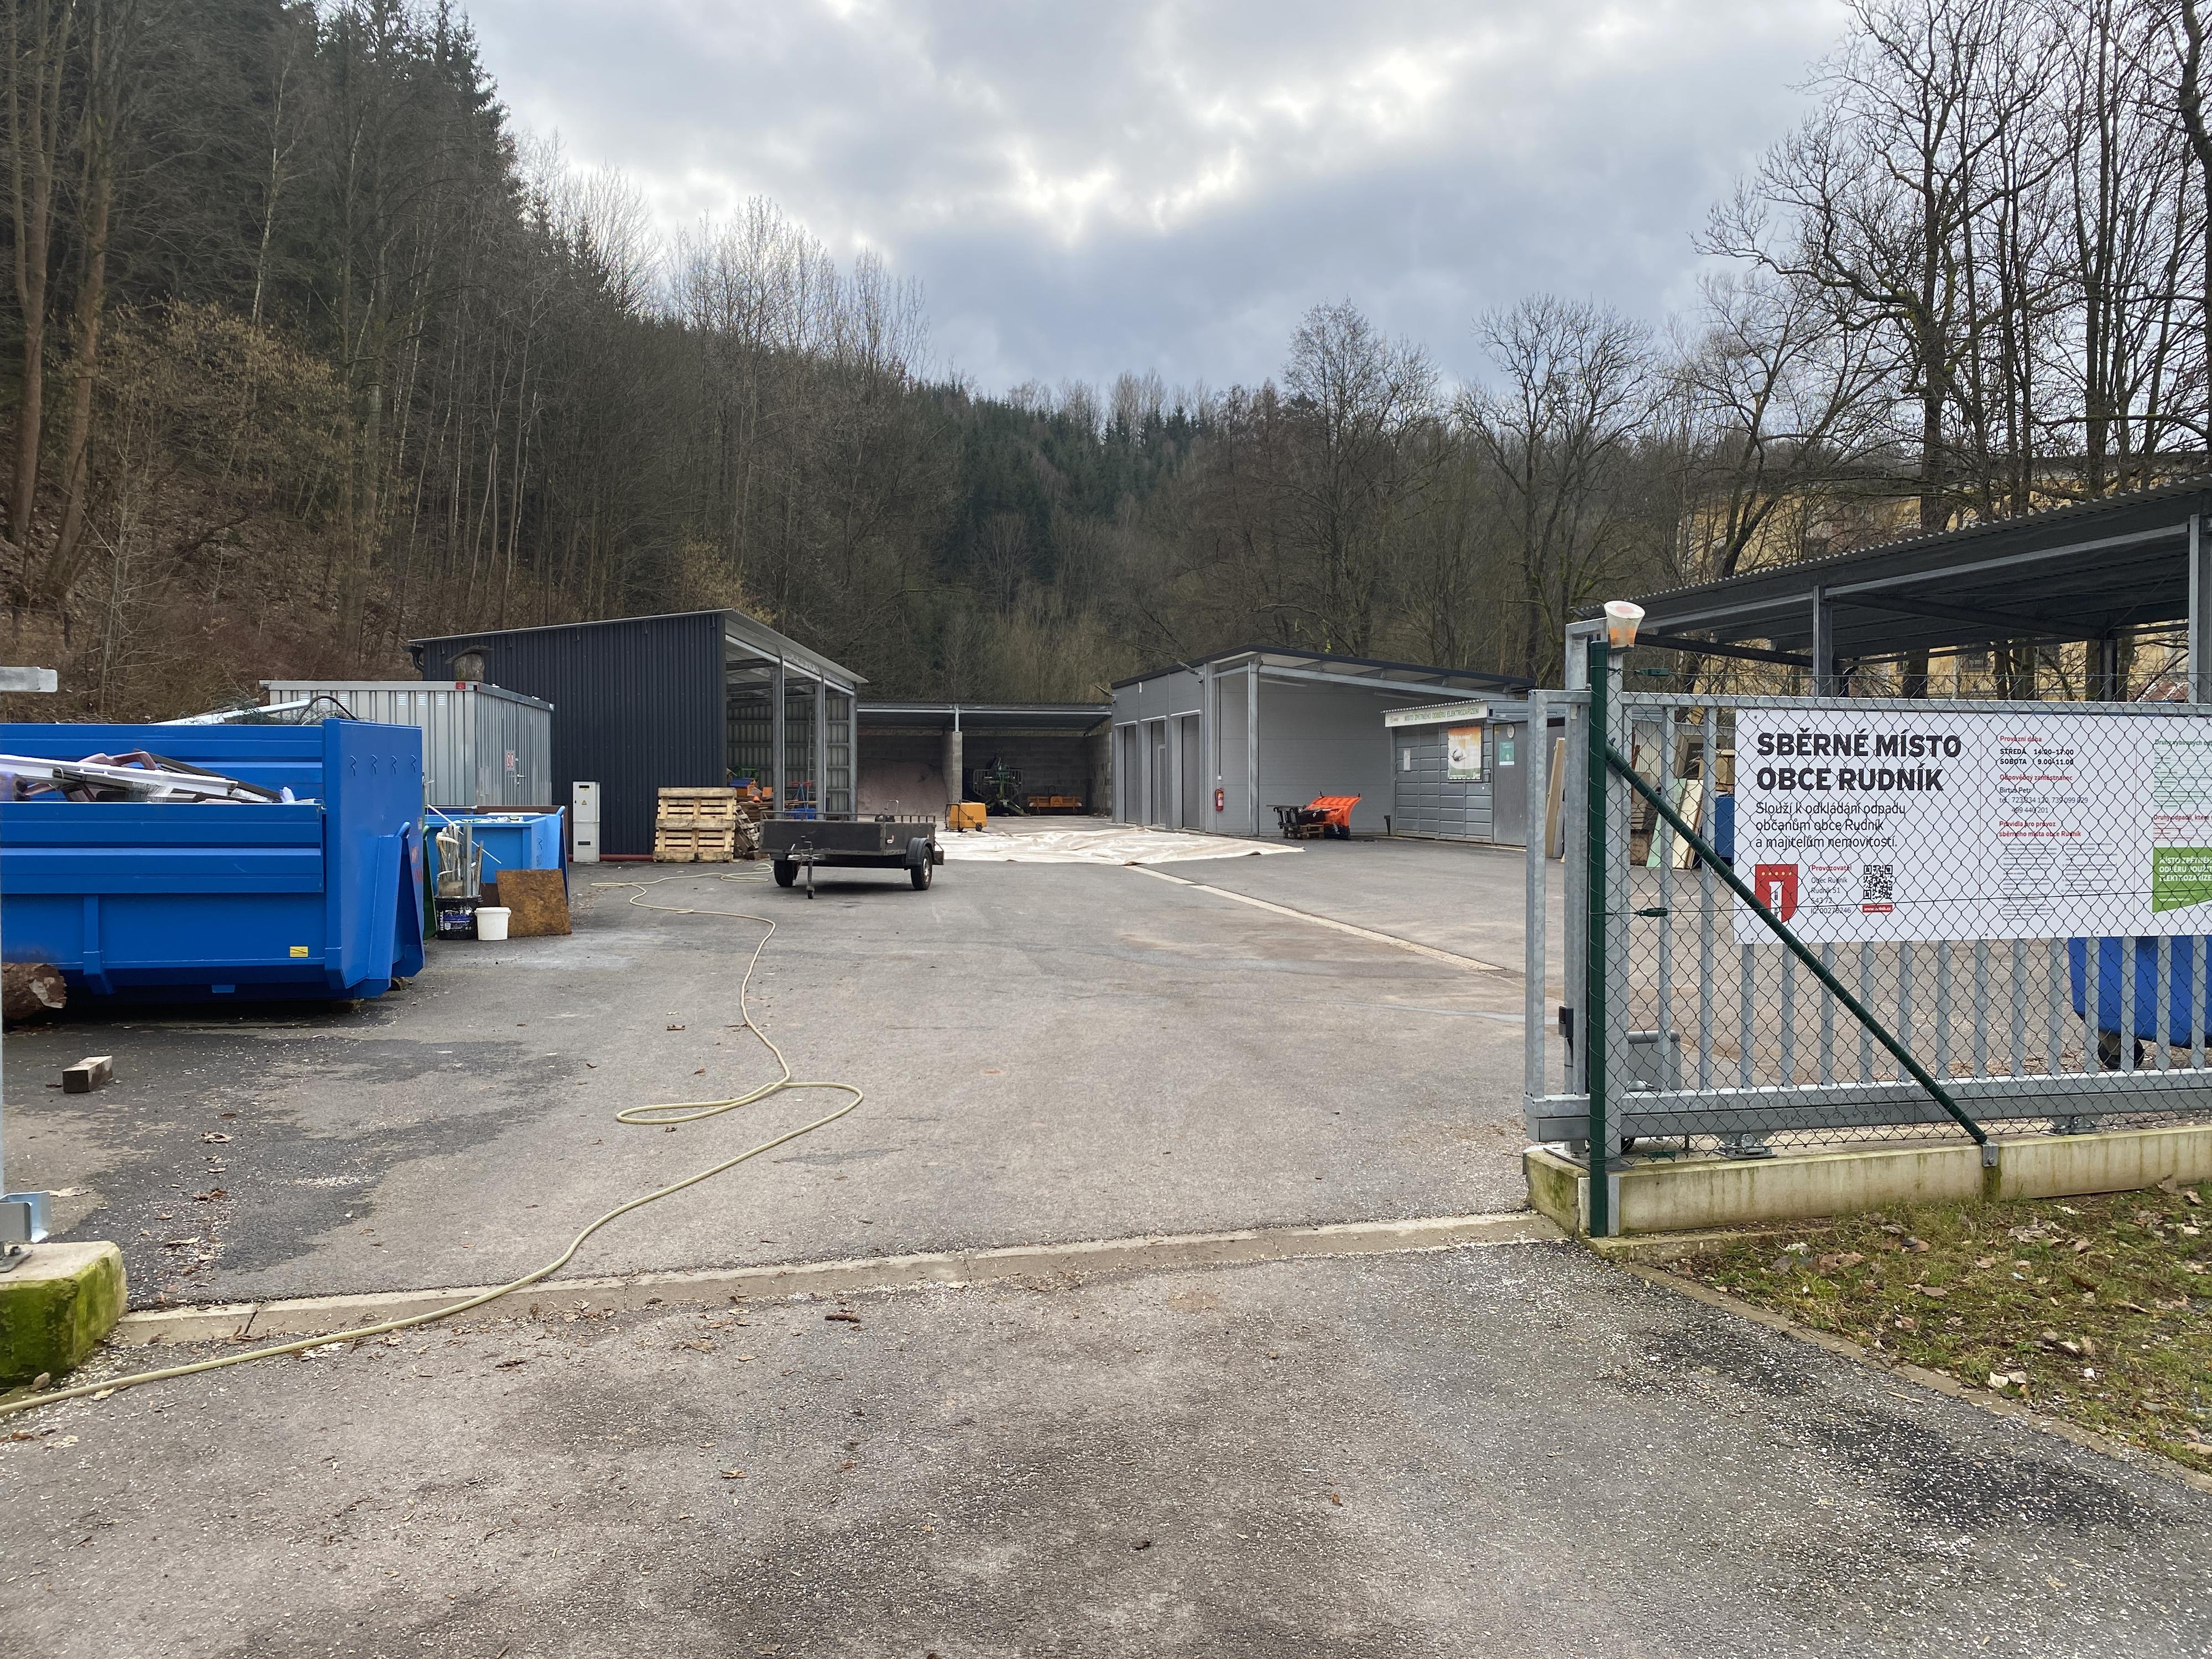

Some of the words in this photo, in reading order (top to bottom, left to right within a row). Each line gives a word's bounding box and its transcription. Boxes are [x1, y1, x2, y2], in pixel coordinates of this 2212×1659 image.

[1757, 727, 1869, 756] SBĚRNÉ
[1876, 729, 1961, 758] MÍSTO
[1756, 766, 1832, 791] OBCE
[1839, 763, 1944, 791] RUDNÍK
[1756, 802, 1792, 814] Slouží
[1796, 802, 1802, 814] k
[1806, 802, 1860, 814] odkládání
[1863, 803, 1906, 817] odpadu
[1756, 818, 1811, 831] občanům
[1814, 818, 1841, 831] obce
[1845, 818, 1884, 831] Rudník
[1755, 838, 1762, 847] a
[1766, 835, 1824, 850] majitelům
[1828, 835, 1898, 847] nemovitostí.
[2159, 855, 2179, 864] MÍSTO
